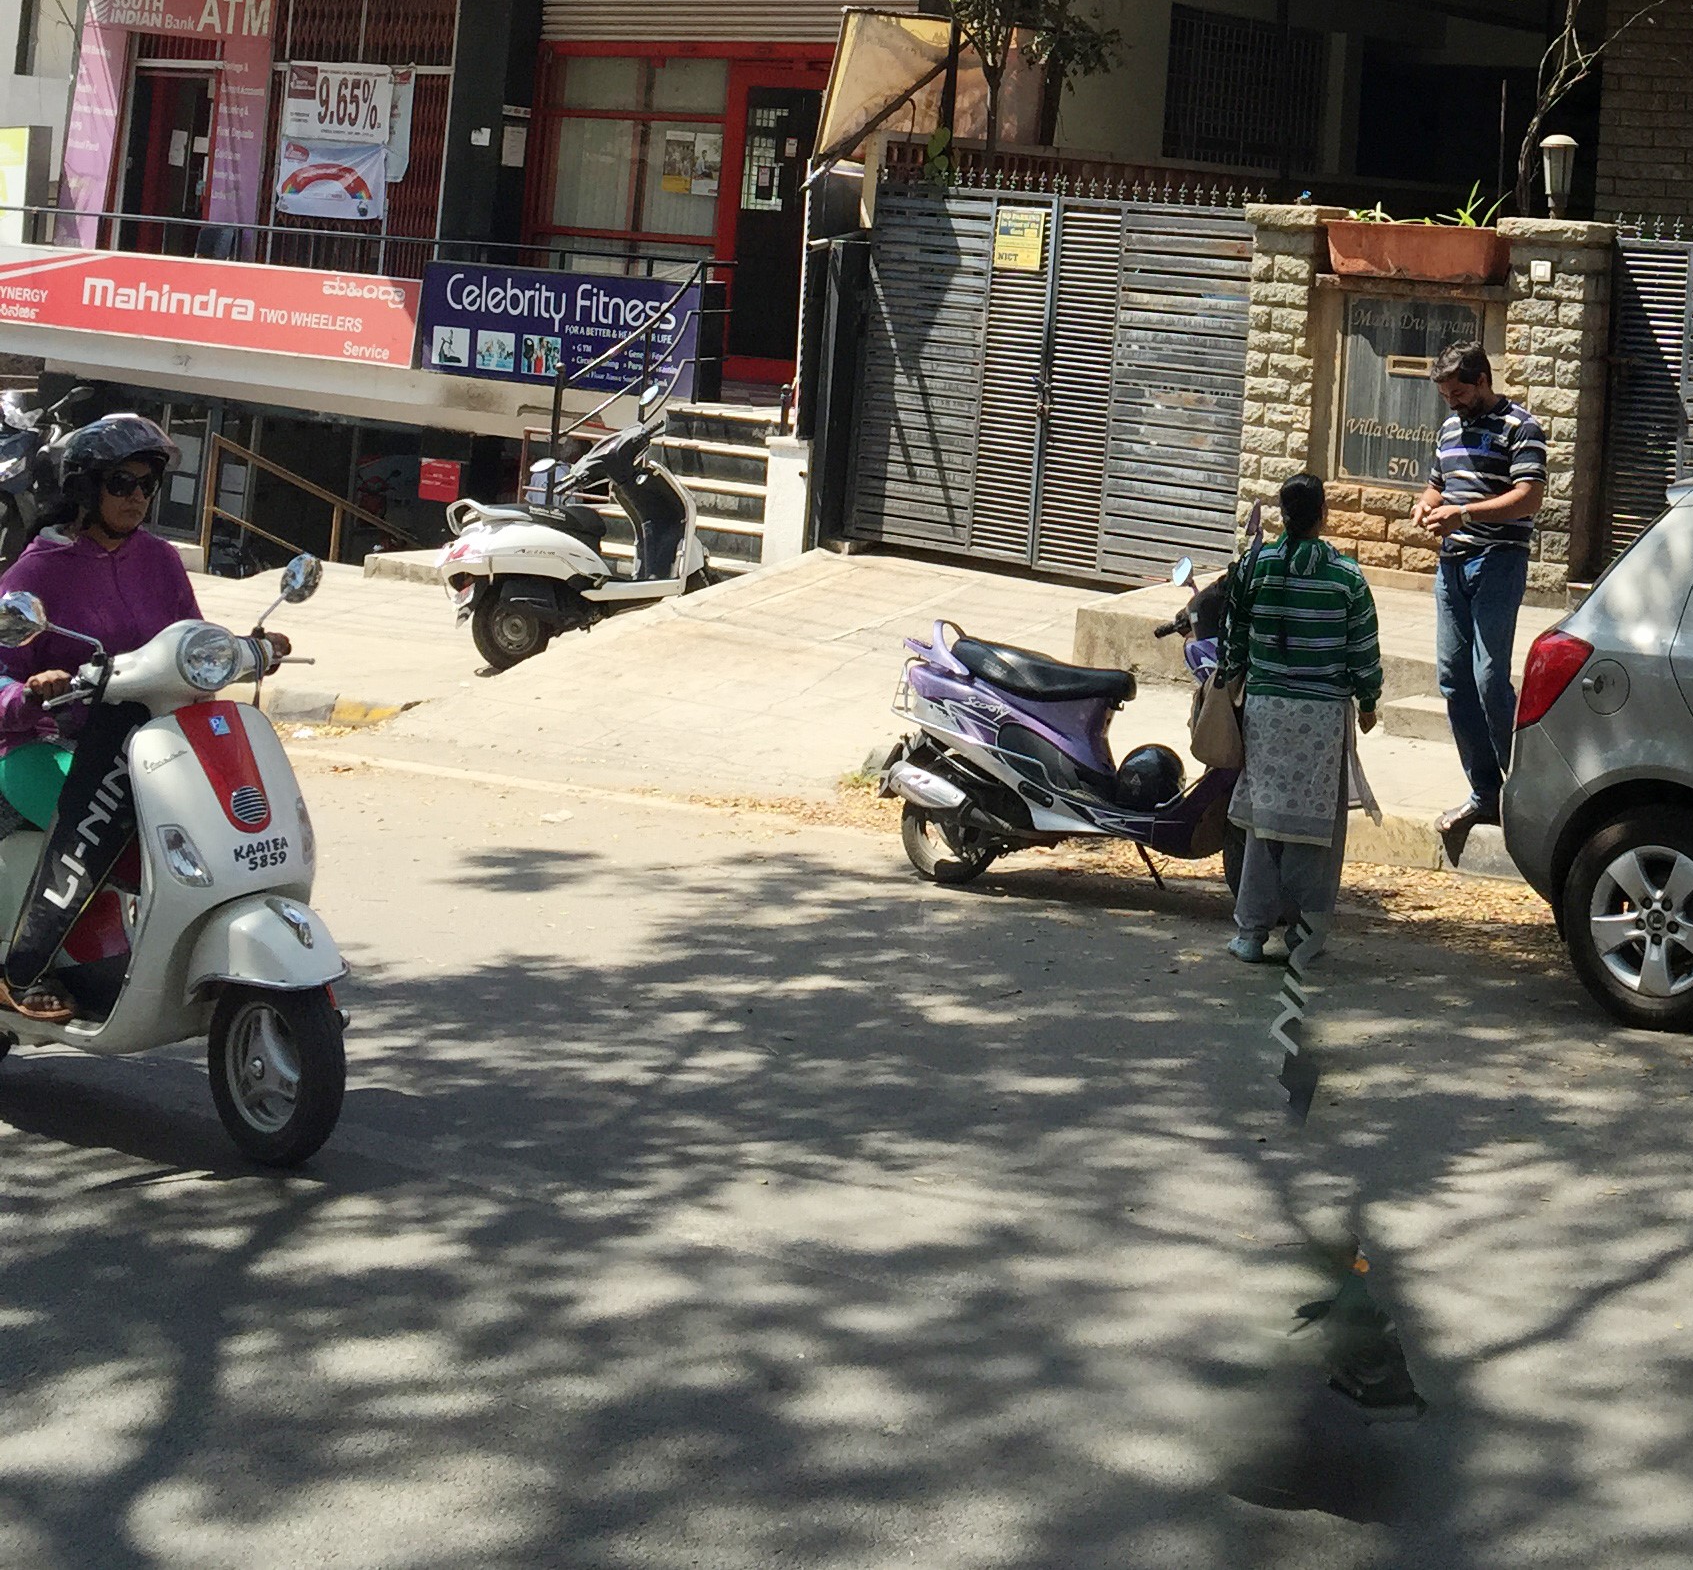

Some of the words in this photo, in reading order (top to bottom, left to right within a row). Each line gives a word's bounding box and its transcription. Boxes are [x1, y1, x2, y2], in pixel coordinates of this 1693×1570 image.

[110, 8, 162, 27] INDIAN
[165, 14, 195, 31] Bank
[317, 76, 378, 130] 9.65%
[82, 276, 254, 322] Mahindra
[259, 307, 288, 325] TWO
[290, 312, 362, 333] WHEELERS
[446, 273, 567, 333] Celebrity
[575, 283, 677, 331] Fitness
[586, 326, 612, 338] BETTER
[657, 334, 673, 344] LIFE
[342, 340, 390, 361] Service
[1346, 417, 1382, 437] Villa
[1385, 422, 1442, 443] Paediat
[1388, 456, 1420, 478] 570
[963, 696, 1013, 721] Scooty
[248, 850, 287, 871] 5859
